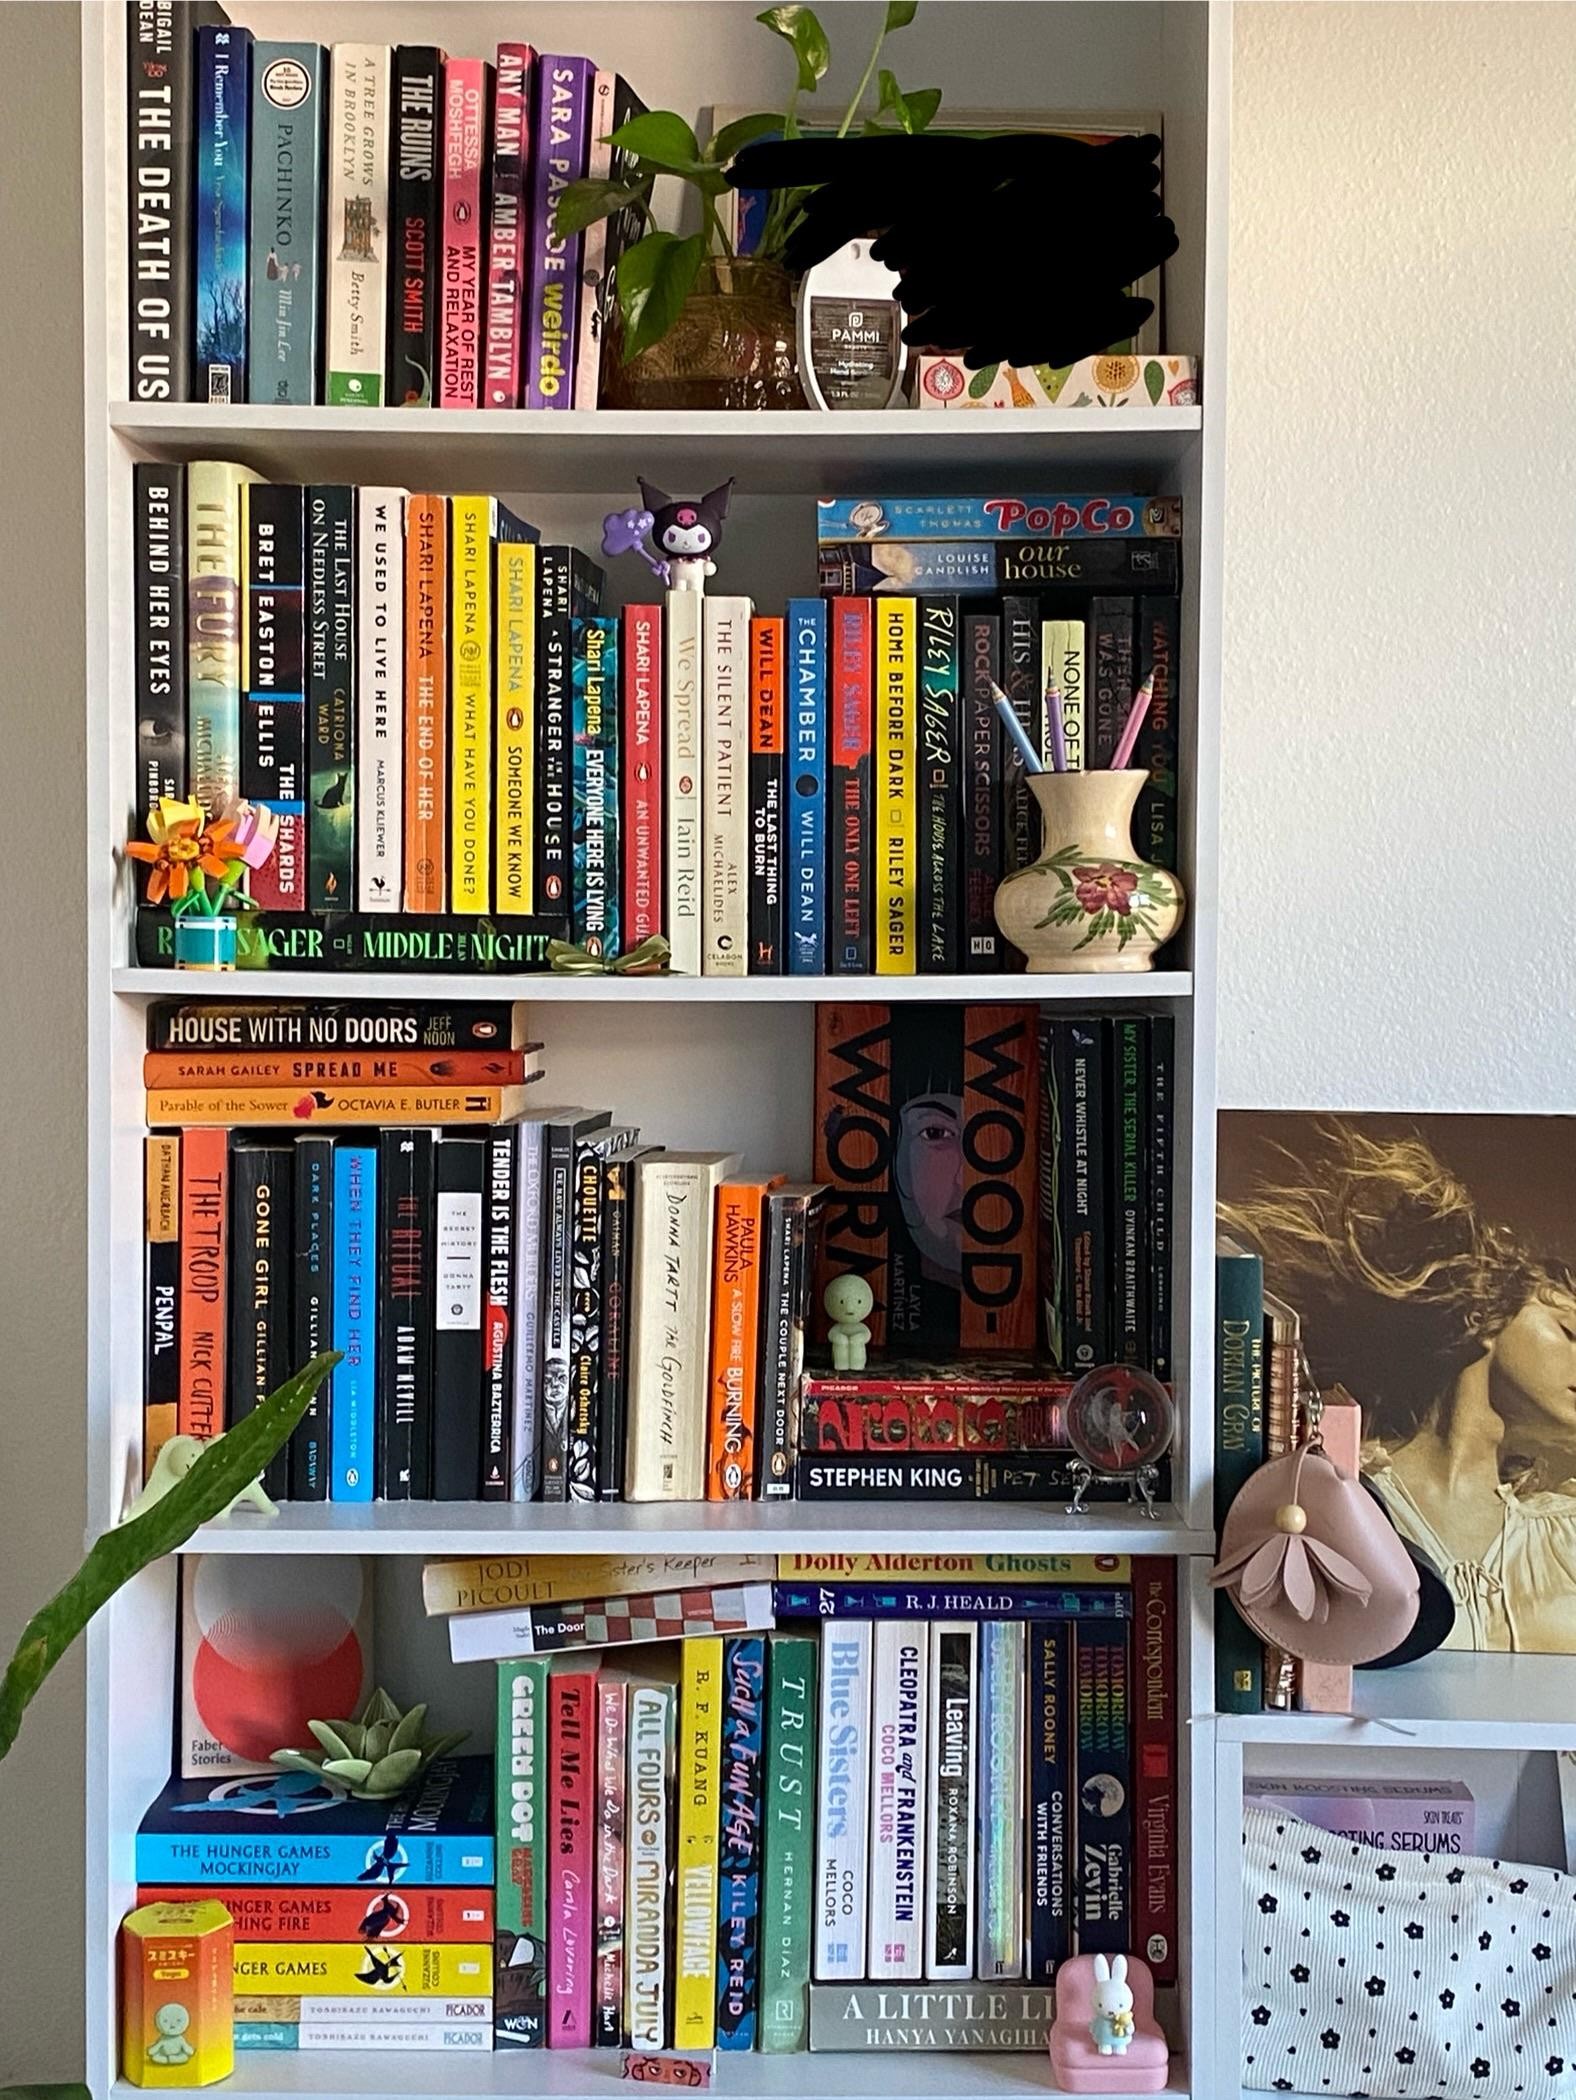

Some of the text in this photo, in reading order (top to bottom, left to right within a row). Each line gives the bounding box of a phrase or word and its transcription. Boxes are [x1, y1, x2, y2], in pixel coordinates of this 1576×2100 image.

[138, 86, 171, 150] THE
[343, 62, 357, 180] IN BROOKLYN
[400, 74, 434, 182] THE RUINS
[448, 79, 464, 180] MOSHFEGH
[463, 88, 479, 172] OTTESSA
[496, 54, 523, 156] ANY MAN
[549, 68, 574, 145] SARA
[138, 167, 170, 281] DEATH
[276, 124, 293, 247] PACHINKO
[403, 217, 425, 334] SCOTT SMITH
[488, 191, 520, 380] AMBER TAMBLYN
[137, 298, 170, 340] OF
[444, 245, 461, 399] AND RELAXATION
[460, 246, 476, 403] MY YEAR OF REST
[538, 284, 569, 397] weirdo
[832, 330, 880, 343] PAMMI
[137, 355, 170, 399] US
[149, 486, 171, 694] BEHIND HER EYES
[417, 512, 435, 660] SHARI LAPENA
[464, 512, 477, 636] SHARI LAPENA
[542, 556, 554, 619] LAPENA
[557, 565, 568, 613] SHARI
[915, 564, 990, 576] CANDLISH
[937, 553, 990, 564] LOUISE
[258, 523, 275, 768] BRET EASTON ELLIS
[375, 504, 388, 739] WE USED TO LIVE HERE
[507, 557, 523, 694] SHARI LAPENA
[464, 693, 477, 742] WHAT
[545, 642, 563, 752] STRANGER
[583, 629, 606, 736] Shari Lapena
[635, 620, 651, 746] SHARI LAPENA
[716, 619, 733, 816] THE SILENT PATIENT
[798, 628, 817, 762] CHAMBER
[316, 703, 330, 745] WARD
[333, 688, 347, 762] CATRIONA
[463, 748, 477, 792] HAVE
[463, 797, 476, 833] YOU
[754, 807, 766, 877] TO BURN
[766, 778, 778, 906] THE LAST THING
[462, 839, 476, 896] DONE?
[713, 834, 724, 924] MICHAELIDES
[801, 810, 815, 923] WILL DEAN
[363, 931, 453, 960] MIDDLE
[470, 933, 549, 962] NIGHT
[169, 1016, 419, 1044] HOUSE WITH NO DOORS
[423, 1030, 456, 1046] NOON
[178, 1064, 281, 1077] SARAH GAILEY
[292, 1061, 399, 1078] SPREAD ME
[1074, 1057, 1087, 1098] NEVER
[1075, 1101, 1088, 1156] WHISTLE
[1075, 1159, 1088, 1175] AT
[489, 1138, 512, 1307] TENDER IS THE FLESH
[582, 1164, 598, 1243] CHOUETTE
[1076, 1178, 1088, 1216] NIGHT
[254, 1183, 271, 1310] GONE GIRL
[724, 1203, 741, 1283] HAWKINS
[740, 1217, 756, 1270] PAULA
[1124, 1208, 1136, 1333] OYINKAN BRAITHWAITE
[153, 1285, 175, 1355] PENPAL
[189, 1331, 214, 1370] NICK
[255, 1320, 268, 1387] GILLIAN
[490, 1320, 504, 1454] AGUSTINA BAZTERRICA
[775, 1291, 790, 1446] THE COUPLE NEXT DOOR
[1223, 1320, 1251, 1453] DORIAN GRAY
[809, 1467, 963, 1488] STEPHEN KING
[457, 1579, 557, 1608] PICOULT
[534, 1624, 556, 1637] The
[557, 1621, 587, 1635] Door
[826, 1641, 860, 1839] Blue Sisters
[940, 1697, 969, 1778] Leaving
[1043, 1639, 1056, 1766] SALLY ROONEY
[191, 1739, 224, 1751] Faber
[191, 1753, 232, 1766] Stories
[636, 1700, 662, 1826] ALL FOURS
[777, 1678, 806, 1831] TRUST
[879, 1724, 896, 1844] COCO MELLORS
[170, 1844, 331, 1860] THE HUNGER GAMES
[946, 1787, 959, 1915] ROXANA ROBINSON
[1036, 1801, 1048, 1908] WITH FRIENDS
[1051, 1790, 1064, 1917] CONVERSATIONS
[1391, 1832, 1461, 1853] SERUMS
[1423, 1810, 1464, 1824] SKIN TREATS
[199, 1862, 301, 1877] MOCKINGJAY
[278, 1900, 332, 1914] GAMES
[825, 1858, 838, 1928] MELLORS
[842, 1870, 854, 1916] COCO
[1084, 1843, 1109, 1921] Zevin
[1108, 1843, 1124, 1921] Gabrielle
[278, 1916, 311, 1931] FIRE
[634, 1862, 660, 2043] MIRANDA JULY
[728, 1873, 747, 2017] KILEY REID
[275, 1961, 328, 1976] GAMES
[843, 1994, 1008, 2021] A LITTLE
[865, 2028, 938, 2046] HANYA
